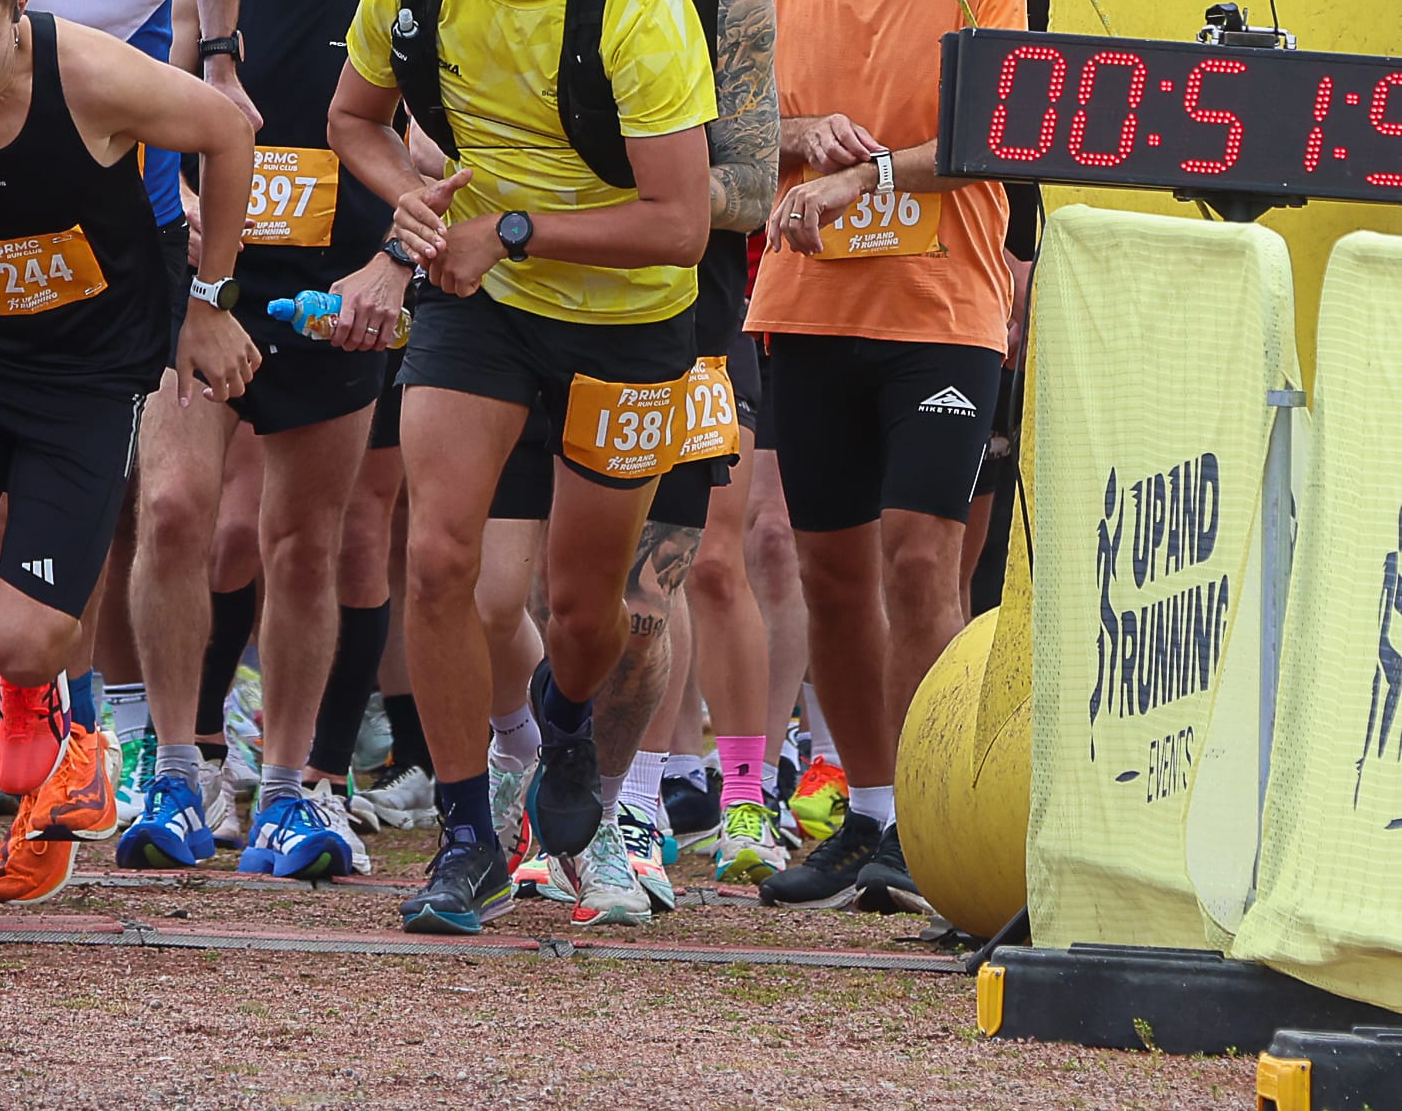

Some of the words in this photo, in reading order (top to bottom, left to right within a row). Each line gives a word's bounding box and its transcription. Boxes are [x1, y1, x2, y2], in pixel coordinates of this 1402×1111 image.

[264, 152, 298, 164] RMC
[279, 164, 298, 172] CLUB
[246, 174, 318, 217] 397
[267, 221, 287, 229] AND
[252, 227, 291, 236] RUNNING
[864, 232, 877, 240] UP
[877, 231, 895, 240] AND
[4, 240, 39, 254] RMC
[860, 238, 899, 249] RUNNING
[6, 251, 23, 259] RUN
[23, 248, 44, 257] CLUB
[31, 288, 52, 300] AND
[19, 292, 59, 309] RUNNING
[689, 362, 706, 374] MC
[638, 387, 672, 400] RMC
[637, 400, 653, 408] RUN
[653, 399, 670, 407] CLUB
[686, 382, 732, 431] 23
[918, 405, 943, 413] NIKE
[947, 407, 976, 418] TRAIL
[693, 434, 703, 443] UP
[703, 430, 719, 440] AND
[691, 436, 724, 450] RUNNING
[619, 459, 658, 471] RUNNING
[625, 456, 638, 464] UP
[638, 454, 655, 462] AND
[1130, 472, 1166, 589] UP
[1165, 452, 1219, 577] AND
[1120, 574, 1229, 718] RUNNING
[1147, 725, 1195, 804] EVENTS
